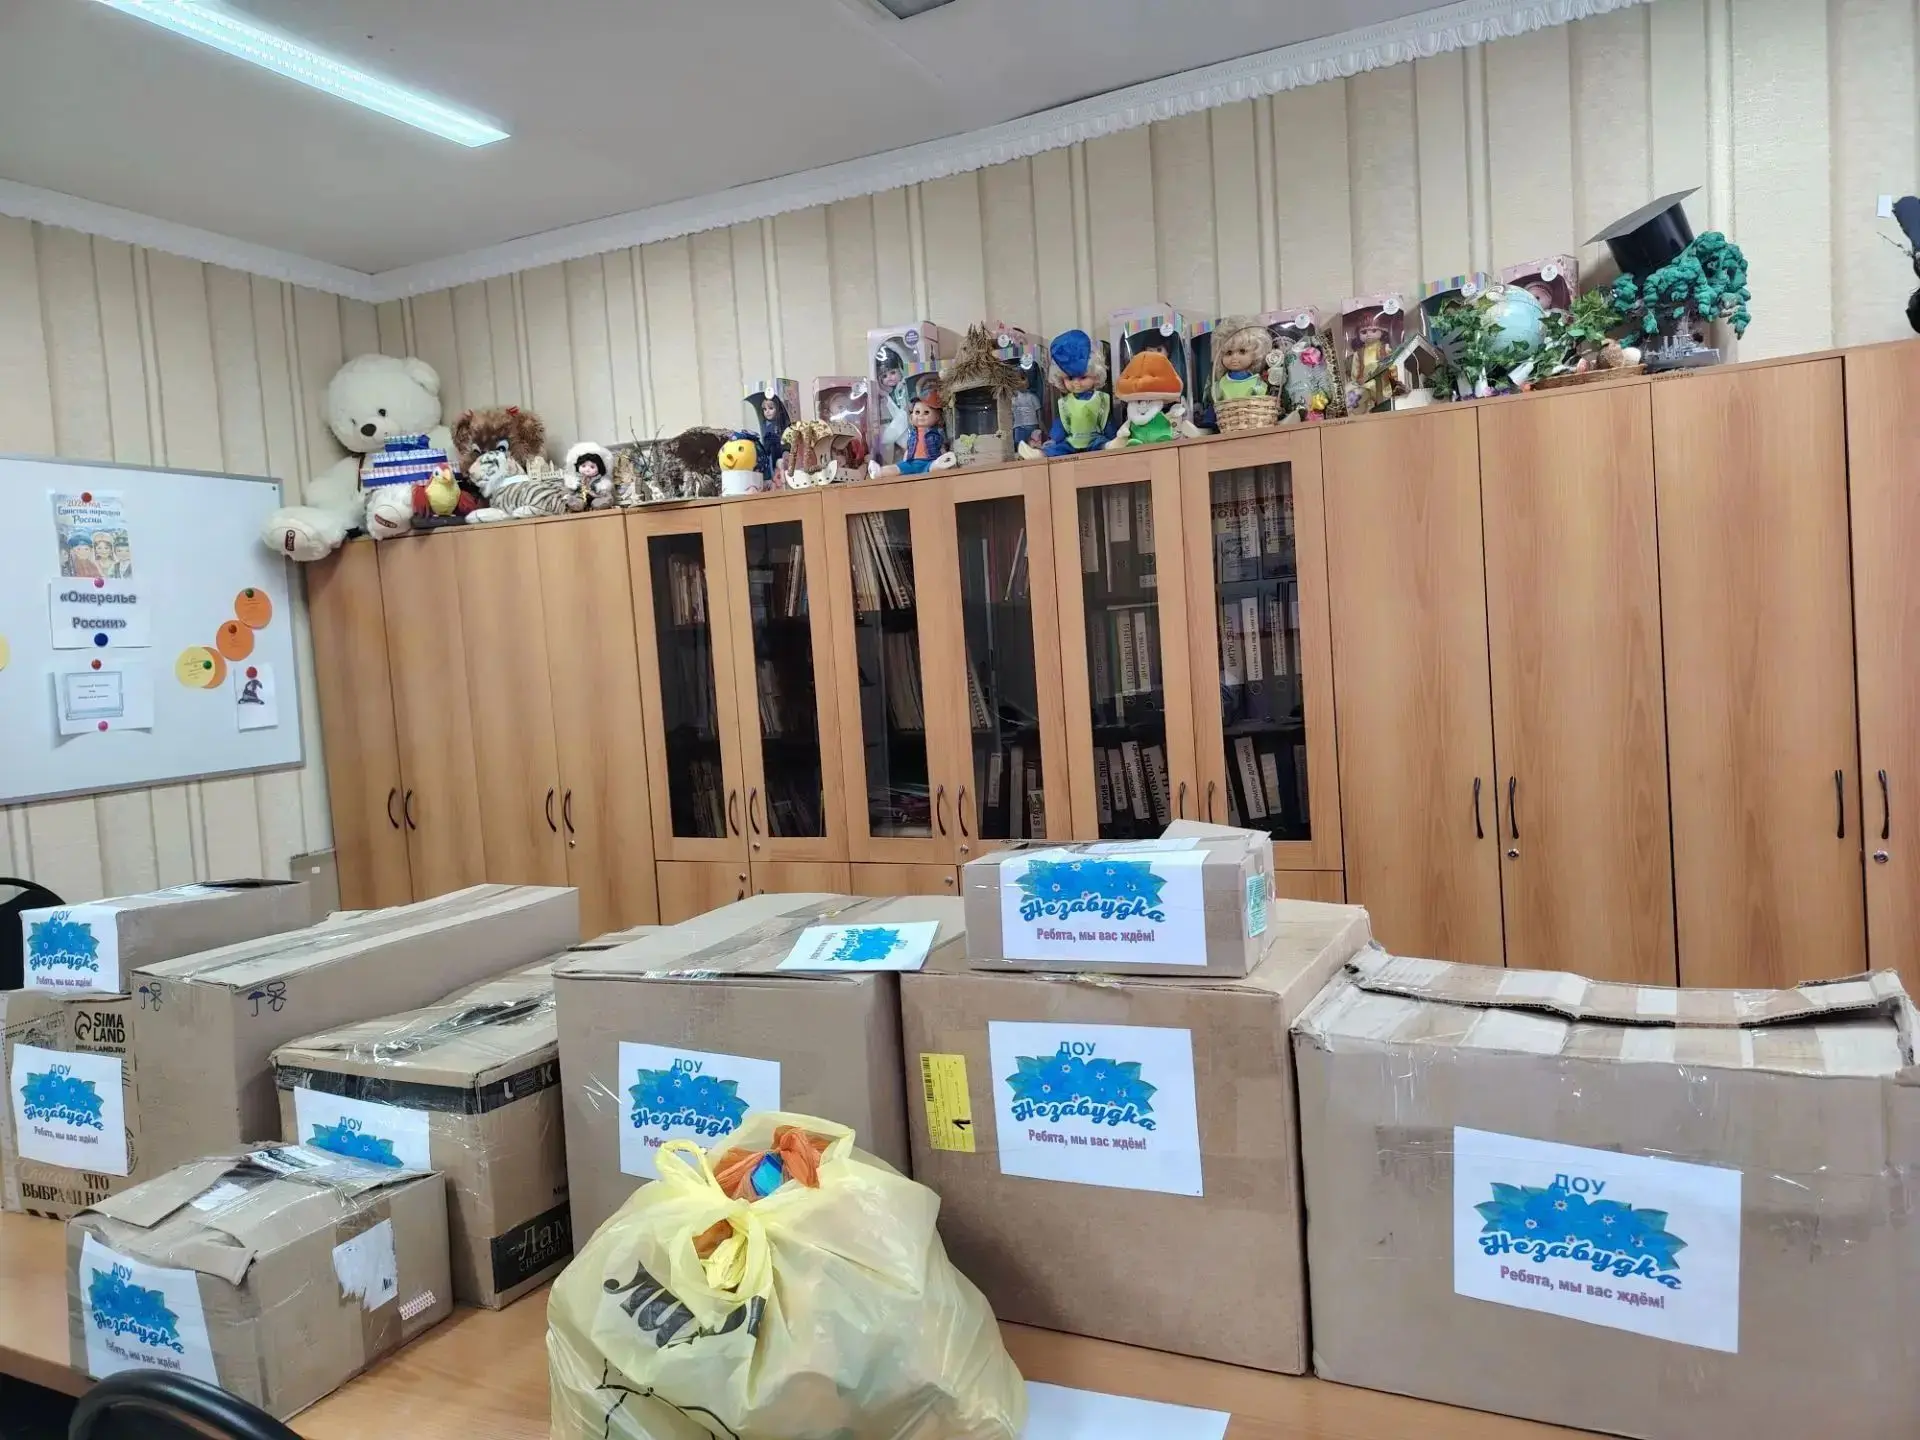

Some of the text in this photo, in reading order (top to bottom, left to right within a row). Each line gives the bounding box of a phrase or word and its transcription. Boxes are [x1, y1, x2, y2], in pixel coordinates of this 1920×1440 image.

[72, 515, 103, 524] России
[60, 590, 137, 606] «Ожерелье
[72, 616, 127, 629] России»
[1019, 894, 1166, 922] Незабудка
[1036, 928, 1155, 944] Ребята, мы вас ждём!
[30, 951, 99, 973] Незабудка
[93, 1012, 125, 1029] SIMA
[93, 1028, 126, 1043] LAND
[1060, 1041, 1096, 1057] ДОУ
[674, 1058, 703, 1073] ДОУ
[24, 1105, 104, 1131] Незабудка
[339, 1116, 363, 1131] ДОУ
[630, 1108, 733, 1137] Незабудк
[1011, 1099, 1156, 1131] Незабудка
[1028, 1129, 1147, 1151] Ребята, мы вас ждём!
[82, 1173, 110, 1190] ЧТО
[1554, 1173, 1606, 1196] ДОУ
[1479, 1232, 1682, 1290] Незабудка
[1500, 1265, 1665, 1309] Ребята, мы вас ждём!
[93, 1311, 184, 1354] Незабудка
